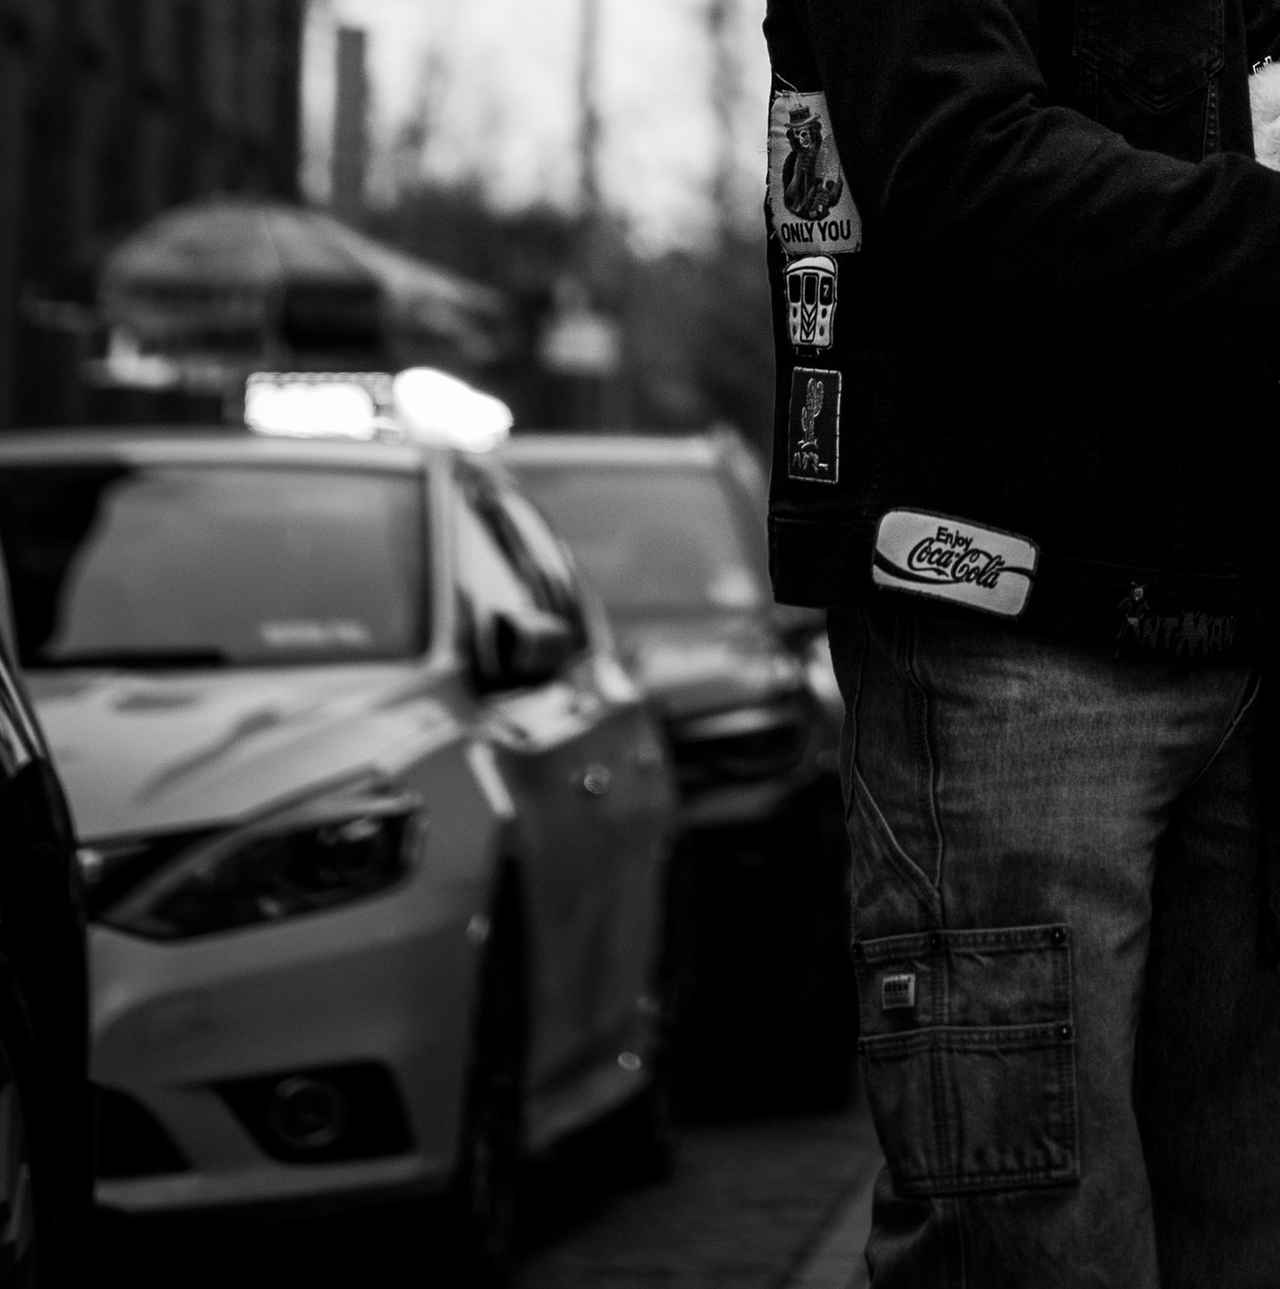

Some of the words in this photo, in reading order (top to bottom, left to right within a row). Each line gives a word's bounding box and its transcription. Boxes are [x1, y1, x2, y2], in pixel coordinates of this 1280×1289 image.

[781, 222, 813, 243] ONLY
[817, 219, 851, 242] YOU
[822, 284, 830, 298] 7
[936, 526, 973, 552] Enjoy
[907, 536, 1005, 589] Coca-Cola
